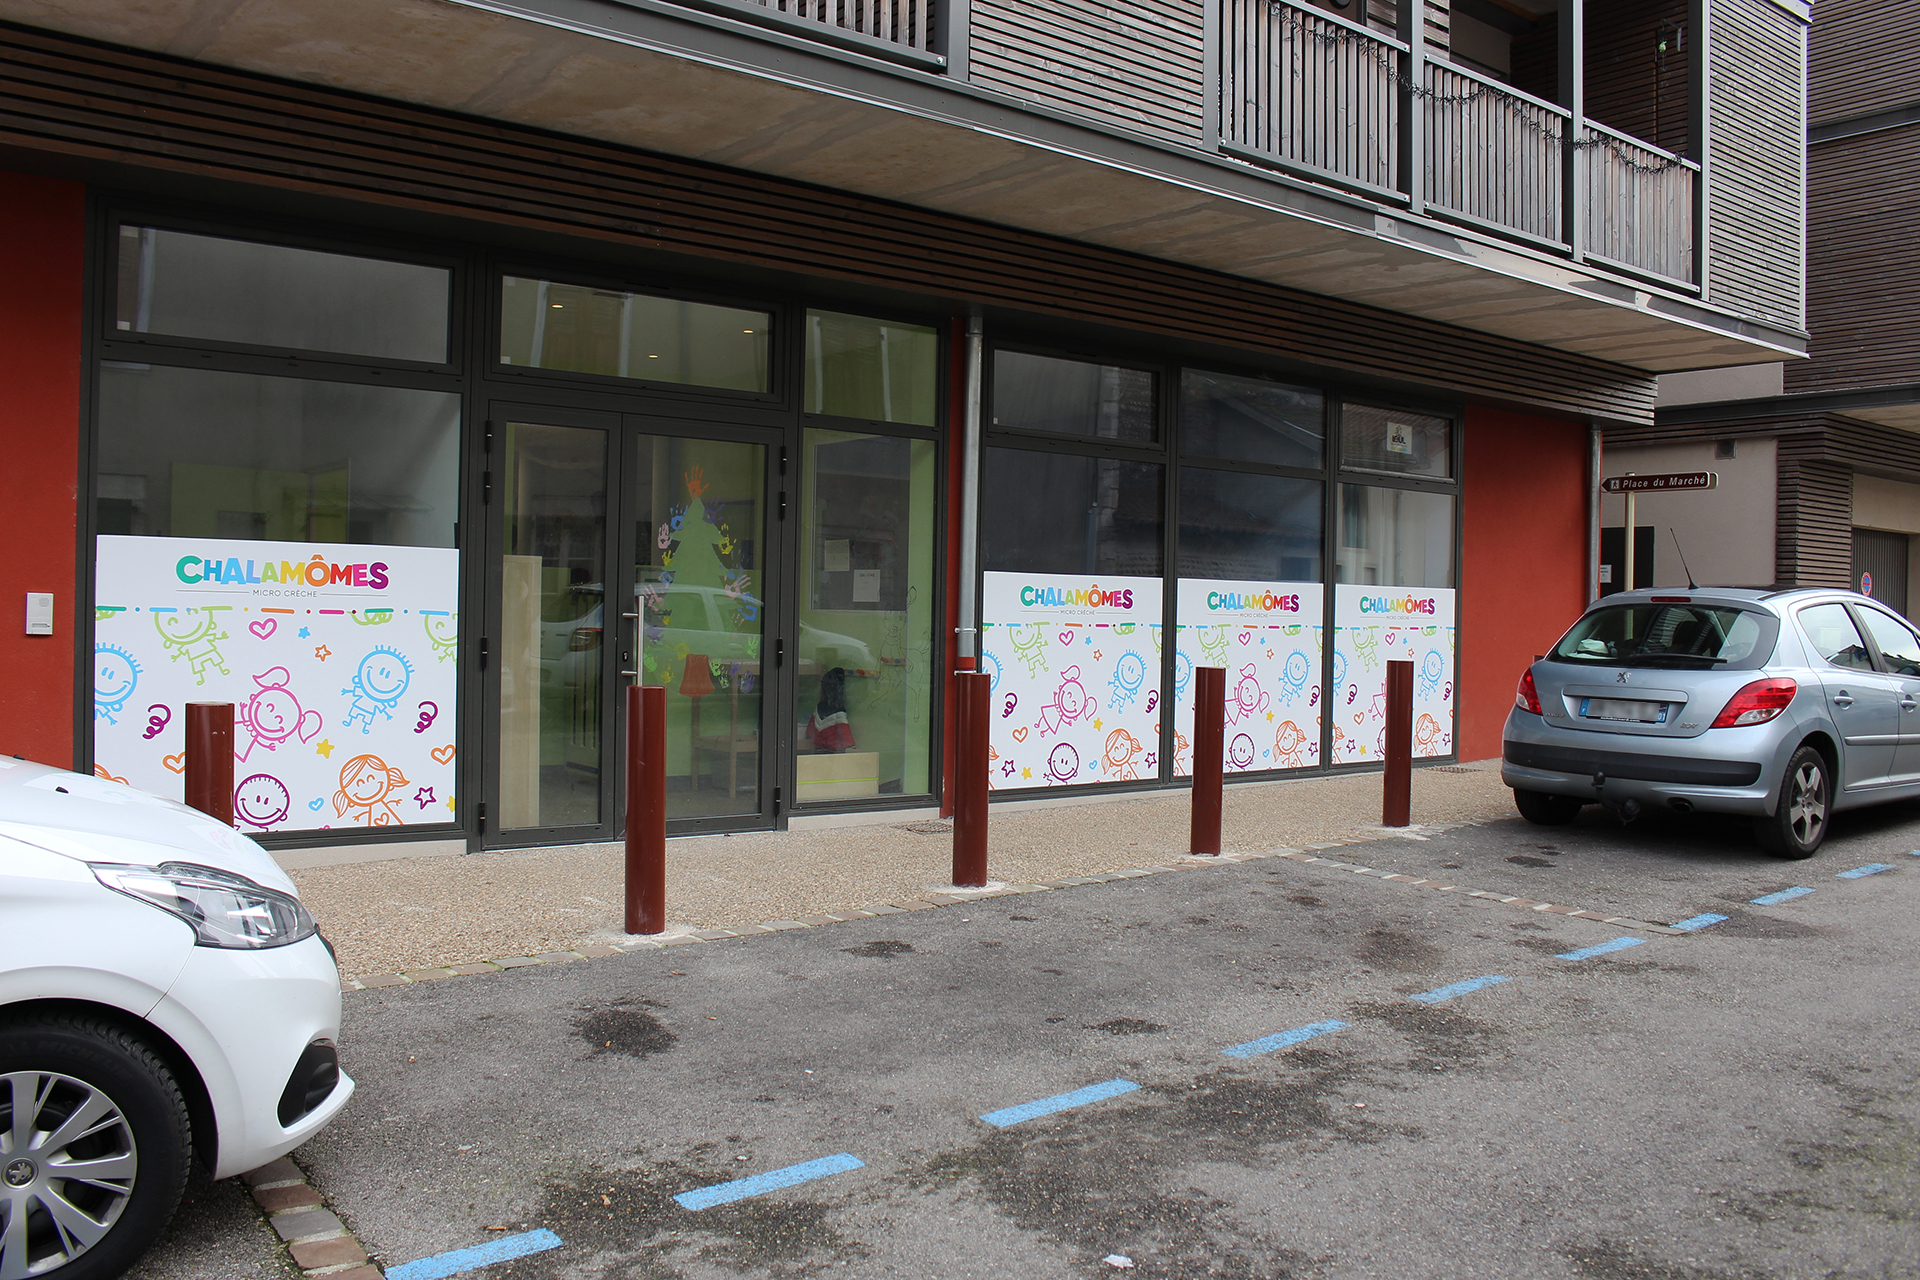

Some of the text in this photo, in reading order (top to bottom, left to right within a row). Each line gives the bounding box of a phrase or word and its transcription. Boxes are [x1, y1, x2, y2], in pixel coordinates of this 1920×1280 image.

[1622, 475, 1706, 488] Place du Marché
[175, 554, 390, 590] CHALAMÔMES
[252, 589, 318, 598] MICRO CRÈCHE
[1020, 584, 1134, 609] CHALAMÔMES
[1207, 589, 1300, 613] CHALAMÔMES
[1360, 594, 1436, 615] CHALAMÔMES
[1657, 712, 1666, 721] 01
